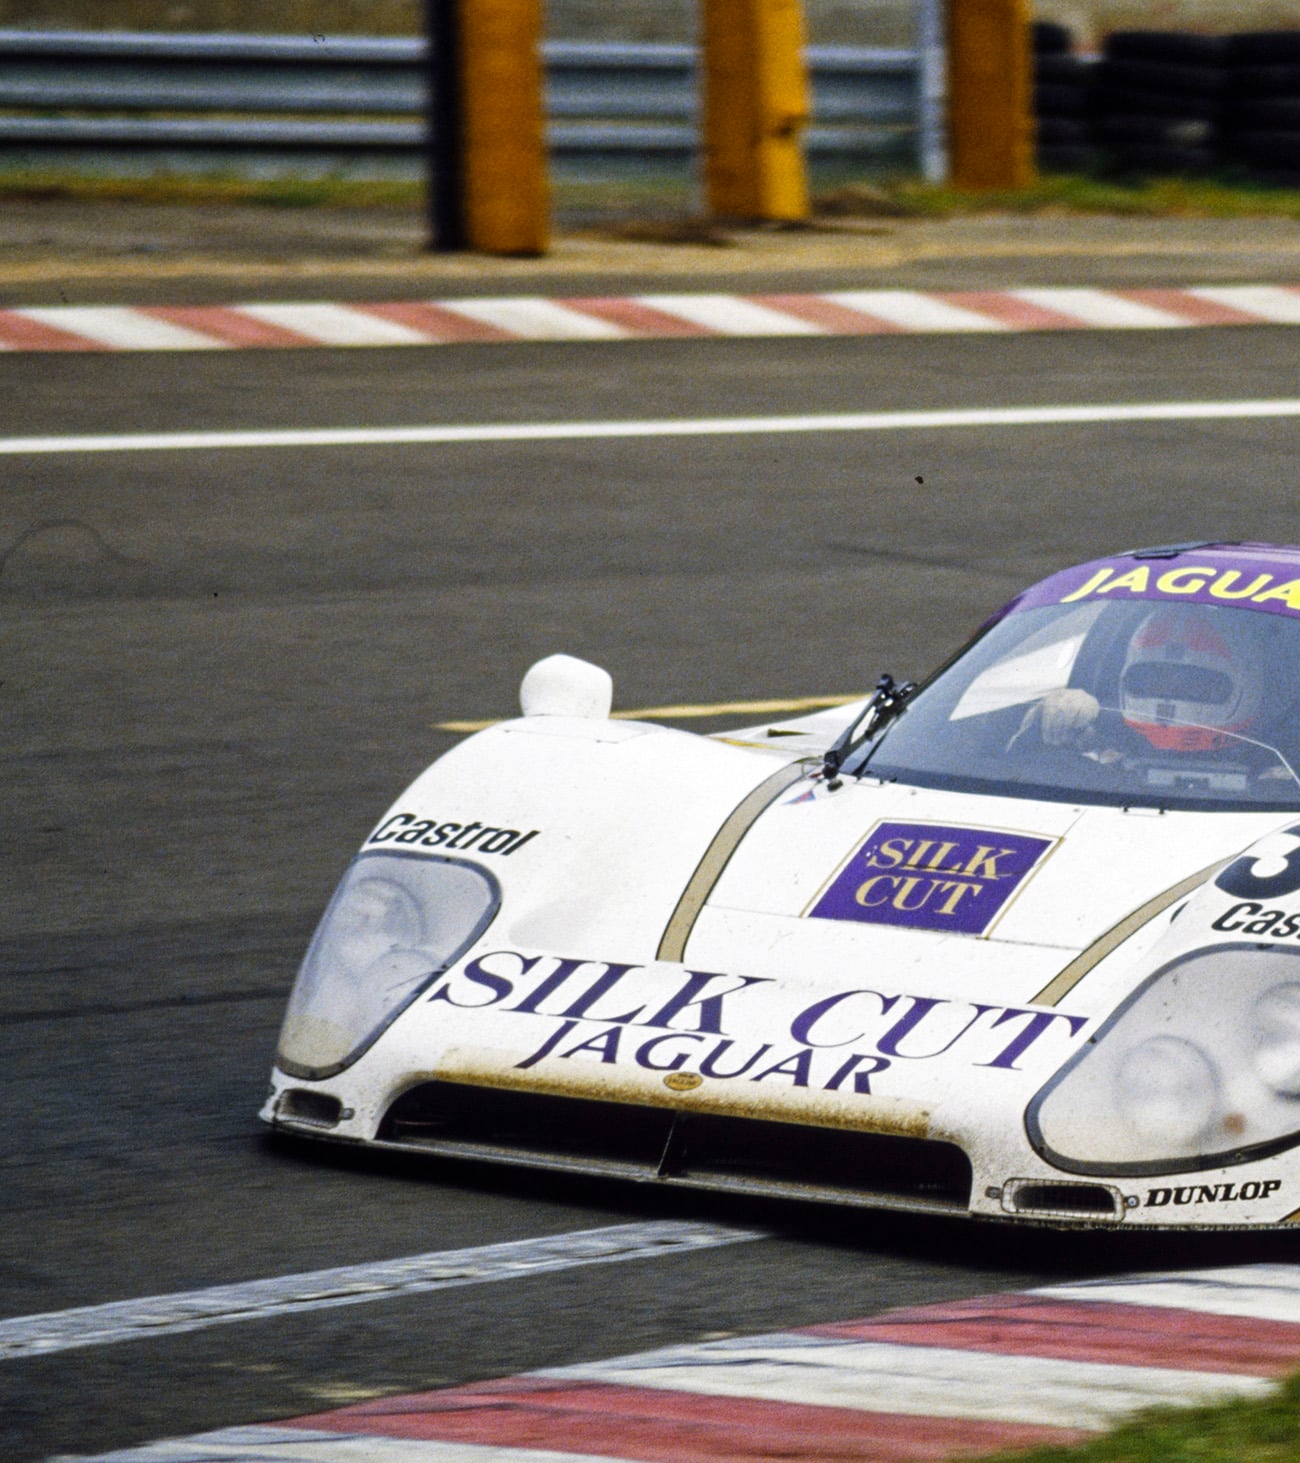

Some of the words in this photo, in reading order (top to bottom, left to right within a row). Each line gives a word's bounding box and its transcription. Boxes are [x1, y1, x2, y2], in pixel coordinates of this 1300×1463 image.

[369, 812, 541, 856] Castrol
[865, 838, 1017, 880] SILK
[855, 875, 983, 916] CUT
[430, 951, 776, 1037] SILK
[790, 990, 1090, 1071] CUT
[515, 1020, 892, 1095] JAGUAR
[1144, 1180, 1282, 1207] DUNLOP
